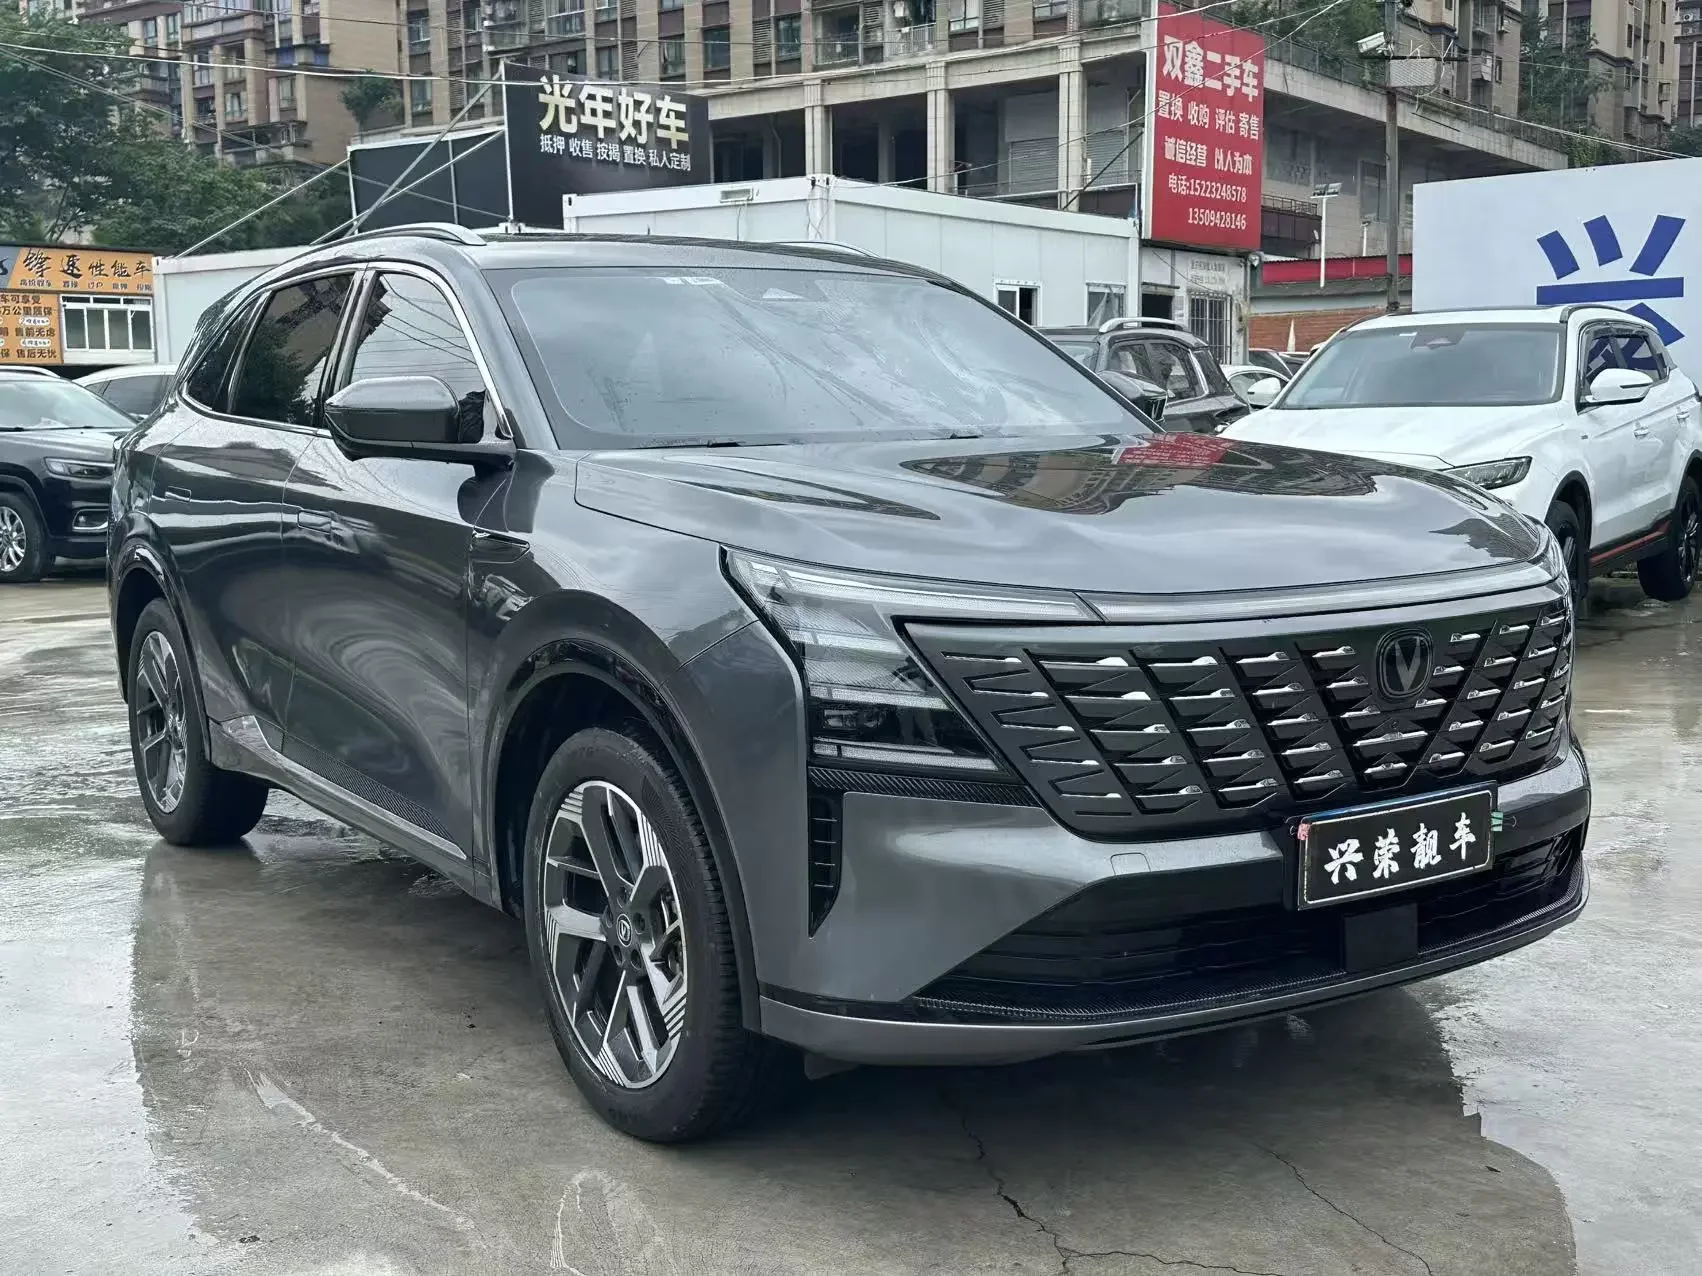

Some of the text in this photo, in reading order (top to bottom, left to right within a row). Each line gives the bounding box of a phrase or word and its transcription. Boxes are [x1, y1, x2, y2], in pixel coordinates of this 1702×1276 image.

[1163, 35, 1259, 102] 双鑫二手车
[538, 74, 689, 149] 光年好车
[1157, 90, 1260, 141] 置换 收购 评估 寄售
[540, 134, 692, 171] 抵押 收售 按揭 置换 私人定制
[1164, 136, 1253, 175] 诚信经营 以人为本
[1168, 173, 1247, 203] 电话:15223248578
[1188, 208, 1247, 230] 13509428146
[0, 305, 53, 316] 万公里质保
[1324, 811, 1476, 885] 兴荣靓车
